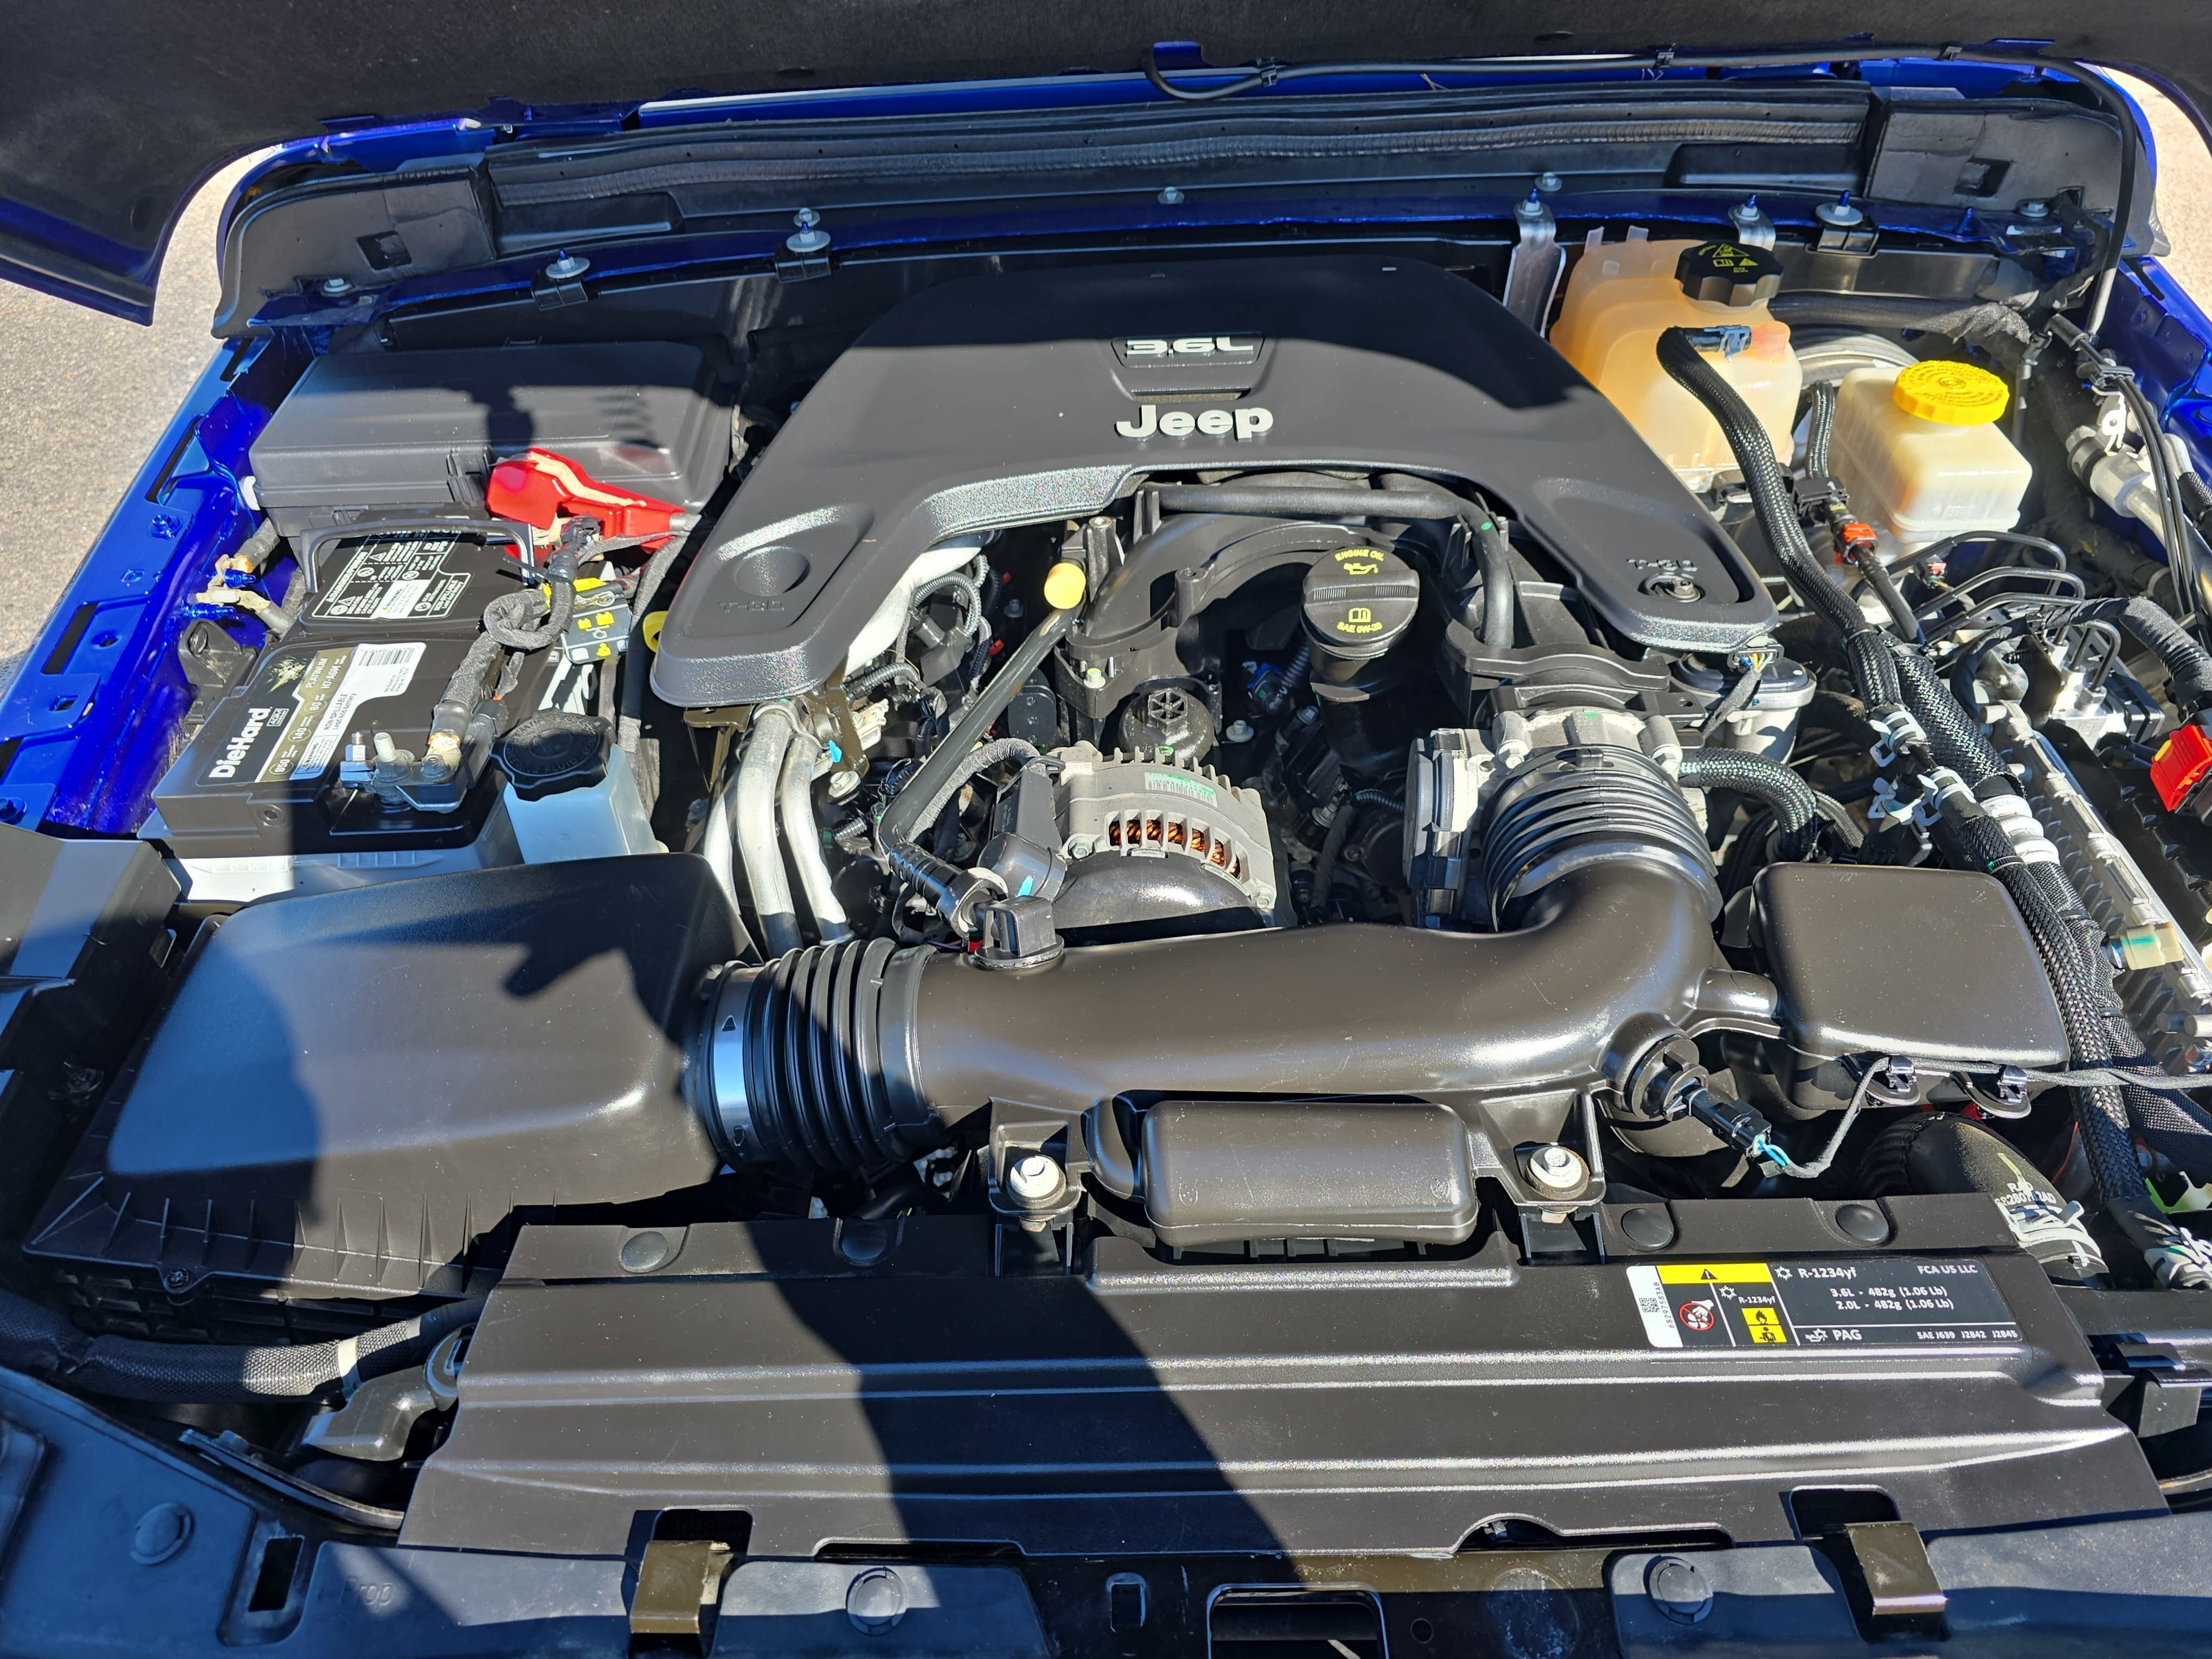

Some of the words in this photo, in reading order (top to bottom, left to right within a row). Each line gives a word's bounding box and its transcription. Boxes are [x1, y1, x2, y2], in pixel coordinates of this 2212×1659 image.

[1126, 336, 1253, 356] 3.6L
[1115, 404, 1274, 441] Jeep
[1335, 549, 1369, 561] ENGINE
[1370, 550, 1384, 562] OIL
[1337, 621, 1355, 633] SAE
[1356, 622, 1382, 633] 0W-20
[305, 658, 329, 688] PLATINUM
[322, 665, 340, 689] H7-AGM
[309, 701, 322, 711] 80
[323, 693, 349, 730] NON-SPILLABLE
[331, 719, 343, 730] Lead
[337, 709, 348, 718] Acid
[343, 693, 357, 709] Battery
[271, 710, 284, 725] AGM
[292, 727, 307, 740] 140
[208, 708, 270, 778] DieHard
[274, 759, 291, 773] 850
[1798, 1266, 1856, 1282] R-1234yf
[1917, 1265, 1940, 1275] FCA
[1942, 1265, 1956, 1274] US
[1957, 1264, 1978, 1274] LLC
[1830, 1288, 1855, 1297] 3.6L
[1868, 1288, 1896, 1298] 482g
[1899, 1287, 1927, 1298] (1.06
[1929, 1285, 1947, 1296] Lb)
[1654, 1282, 1675, 1330] 68297583AB
[1738, 1296, 1776, 1305] R-1234yf
[1836, 1301, 1861, 1310] 2.0L
[1874, 1300, 1902, 1310] 482g
[1905, 1300, 1934, 1310] (1.06
[1935, 1298, 1954, 1310] Lb)
[1833, 1329, 1862, 1341] PAG
[1917, 1331, 1934, 1340] SAE
[1935, 1331, 1954, 1340] J639
[1961, 1330, 1986, 1339] J2842
[1992, 1330, 2018, 1339] J2845
